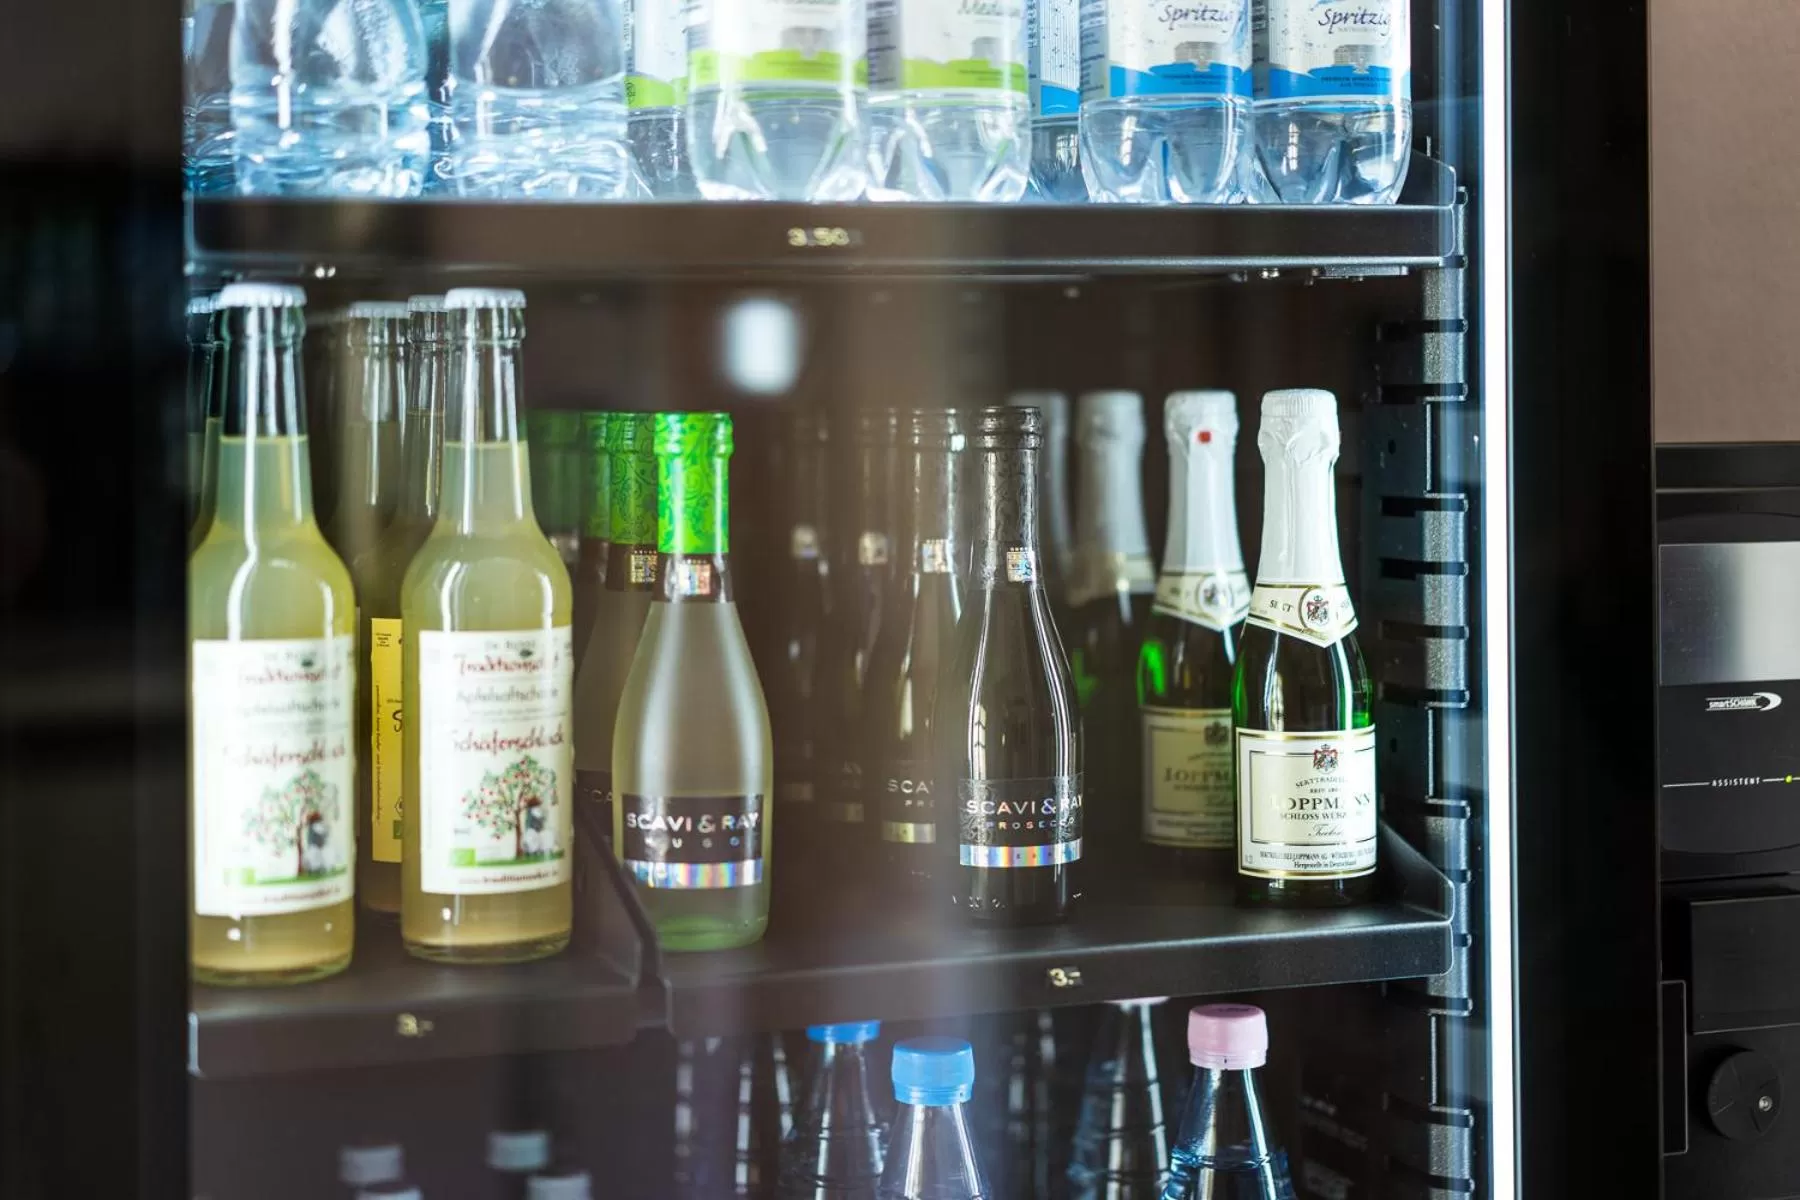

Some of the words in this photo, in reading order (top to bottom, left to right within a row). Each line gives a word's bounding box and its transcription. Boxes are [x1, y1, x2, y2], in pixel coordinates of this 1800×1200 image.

[887, 779, 935, 794] SCA
[1711, 777, 1760, 787] ASSISTENT
[967, 800, 1036, 815] SCAVI
[1041, 798, 1057, 815] &
[626, 812, 692, 832] SCAVI
[698, 814, 716, 833] &
[722, 811, 759, 831] RAY
[984, 816, 1075, 830] PROSECCO
